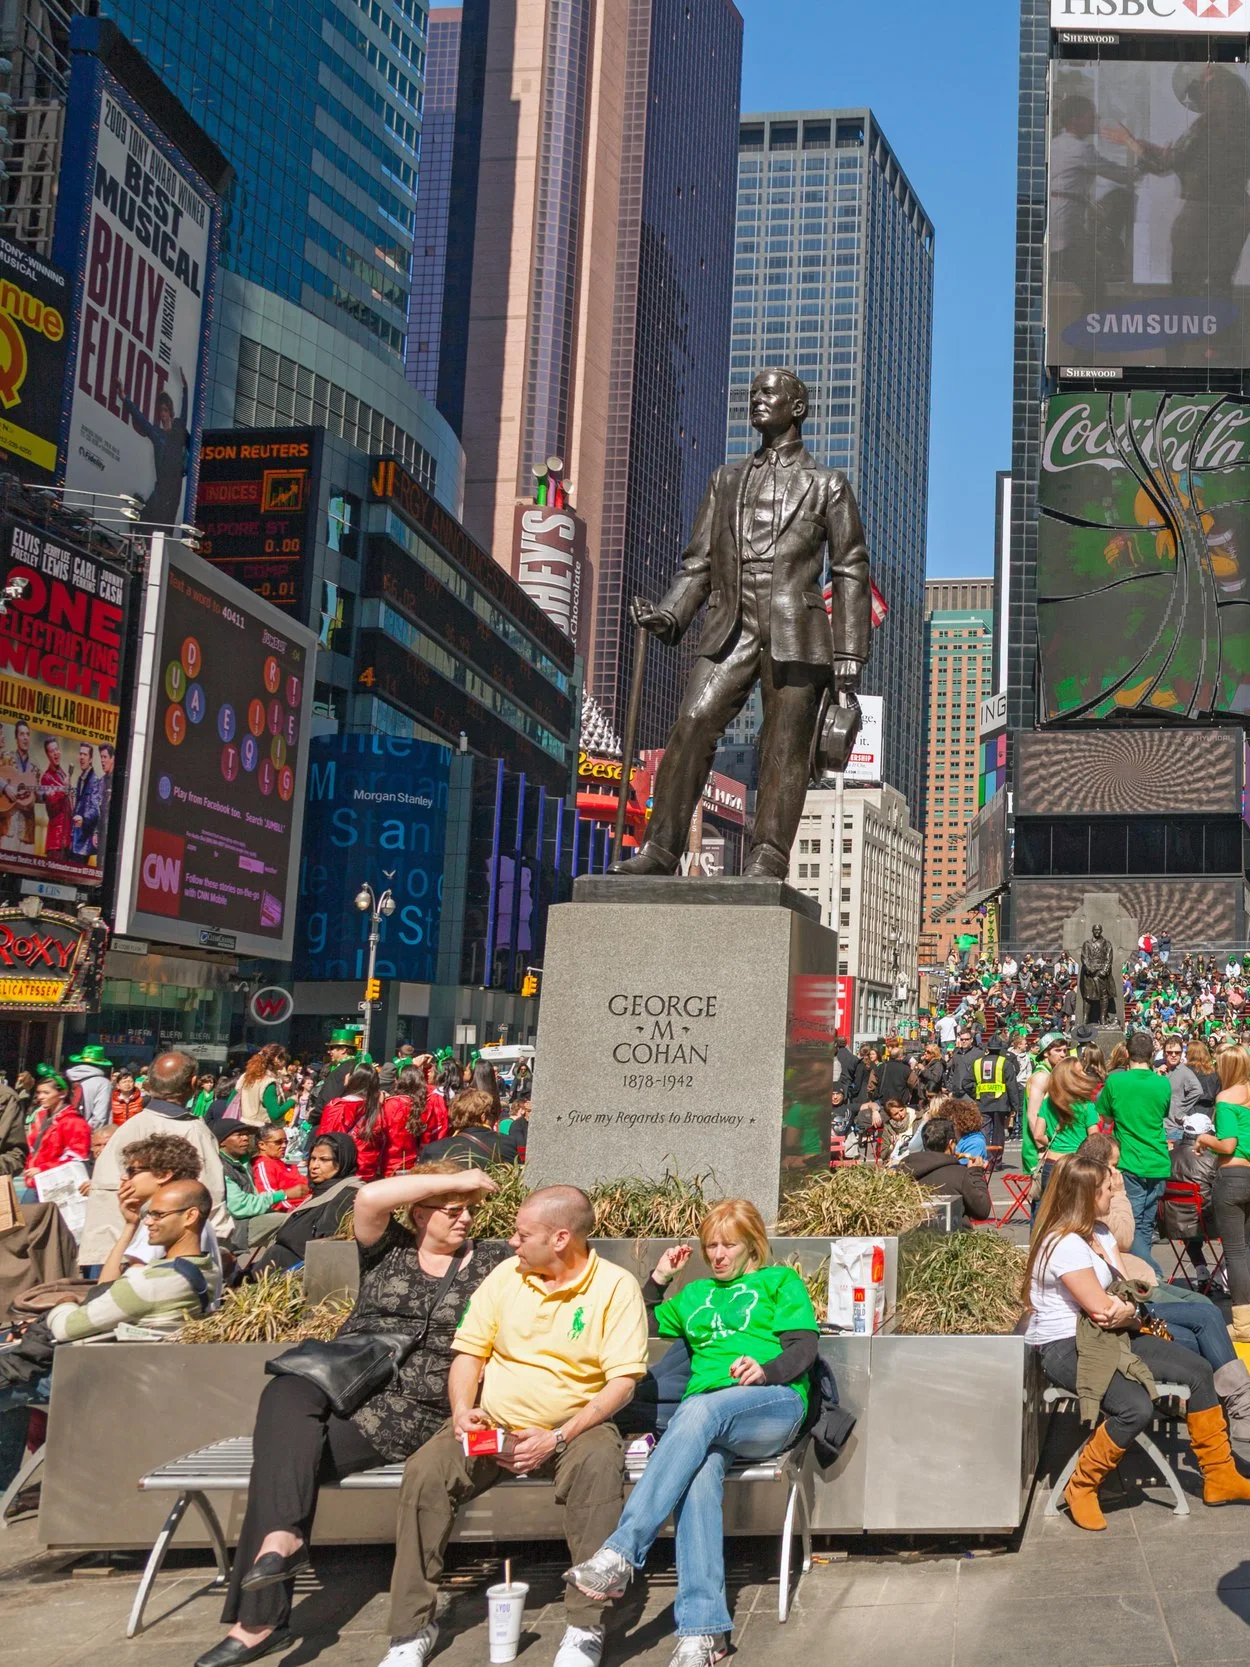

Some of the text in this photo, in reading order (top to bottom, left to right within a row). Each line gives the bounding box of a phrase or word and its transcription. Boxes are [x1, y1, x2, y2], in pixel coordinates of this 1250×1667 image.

[1063, 33, 1115, 43] SHERWOOD
[104, 99, 205, 229] 2009 TONY AWARD WINNER
[125, 152, 183, 239] BEST
[94, 162, 201, 299] MUSICAL
[87, 212, 165, 352] BILLY
[159, 282, 177, 364] THE MUSICAL
[1086, 313, 1217, 334] SAMSUNG
[79, 302, 169, 437] ELLIOT
[1066, 368, 1116, 378] SHERWOOD
[240, 443, 309, 459] REUTERS
[206, 485, 258, 500] INDICES
[13, 527, 41, 556] ELVIS
[43, 542, 72, 564] JERRY LEE
[265, 539, 300, 553] 0.00
[11, 546, 39, 568] PRESLEY
[42, 554, 69, 582] LEWIS
[74, 557, 97, 583] CARL
[101, 569, 124, 589] JOHNNY
[72, 574, 96, 594] PERKINS
[100, 581, 123, 606] CASH
[5, 565, 123, 650] ONE
[221, 605, 246, 630] 40411
[0, 607, 120, 677] ELECTRIFYING
[0, 637, 118, 703] NIGHT
[359, 666, 376, 687] 4
[980, 695, 1007, 725] ING
[32, 714, 116, 742] BY THE TRUE STORY
[173, 785, 188, 802] Play
[203, 796, 230, 816] Facebook
[354, 789, 433, 809] Morgan Stanley
[143, 852, 181, 894] CNN
[0, 924, 76, 968] ROXY
[255, 997, 286, 1017] W
[607, 994, 718, 1018] GEORGE
[650, 1020, 675, 1040] M
[612, 1043, 709, 1066] COHAN
[623, 1075, 694, 1092] 1878-1942
[566, 1110, 744, 1128] Give my Regards to Broadway
